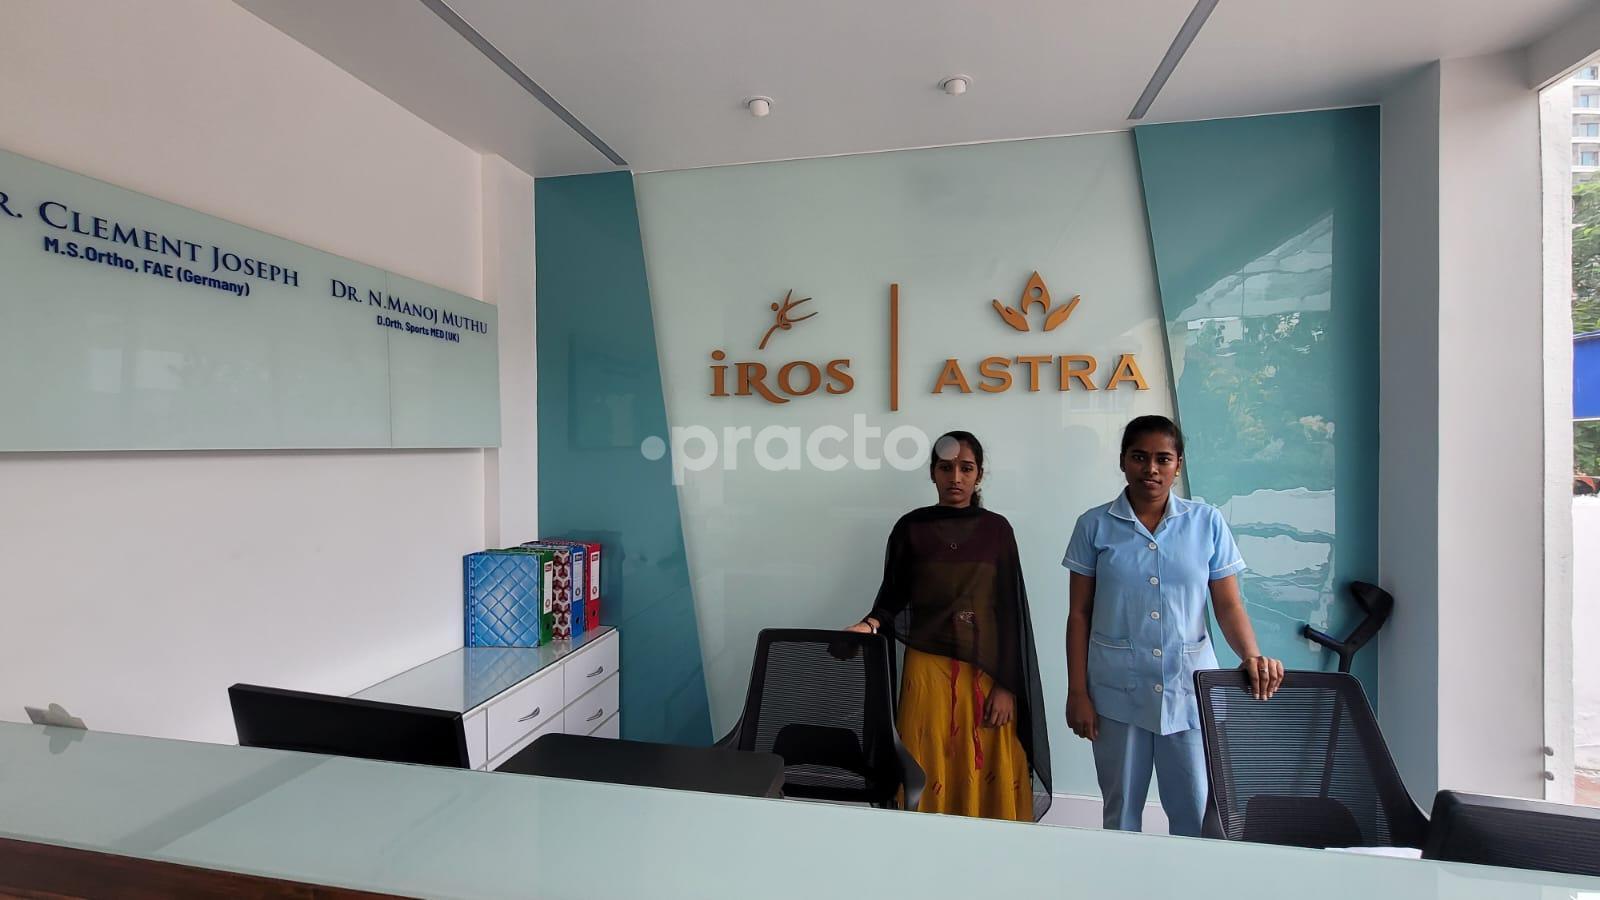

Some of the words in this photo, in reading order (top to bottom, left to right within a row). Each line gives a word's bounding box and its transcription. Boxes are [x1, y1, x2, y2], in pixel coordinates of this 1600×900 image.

[38, 201, 202, 262] CLEMENT
[212, 246, 298, 287] JOSEPH
[143, 259, 173, 279] FAE
[177, 266, 250, 296] (Germany)
[330, 279, 362, 303] DR.
[442, 309, 488, 334] MUTHU
[405, 321, 430, 336] Sports
[931, 353, 1149, 393] ASTRA
